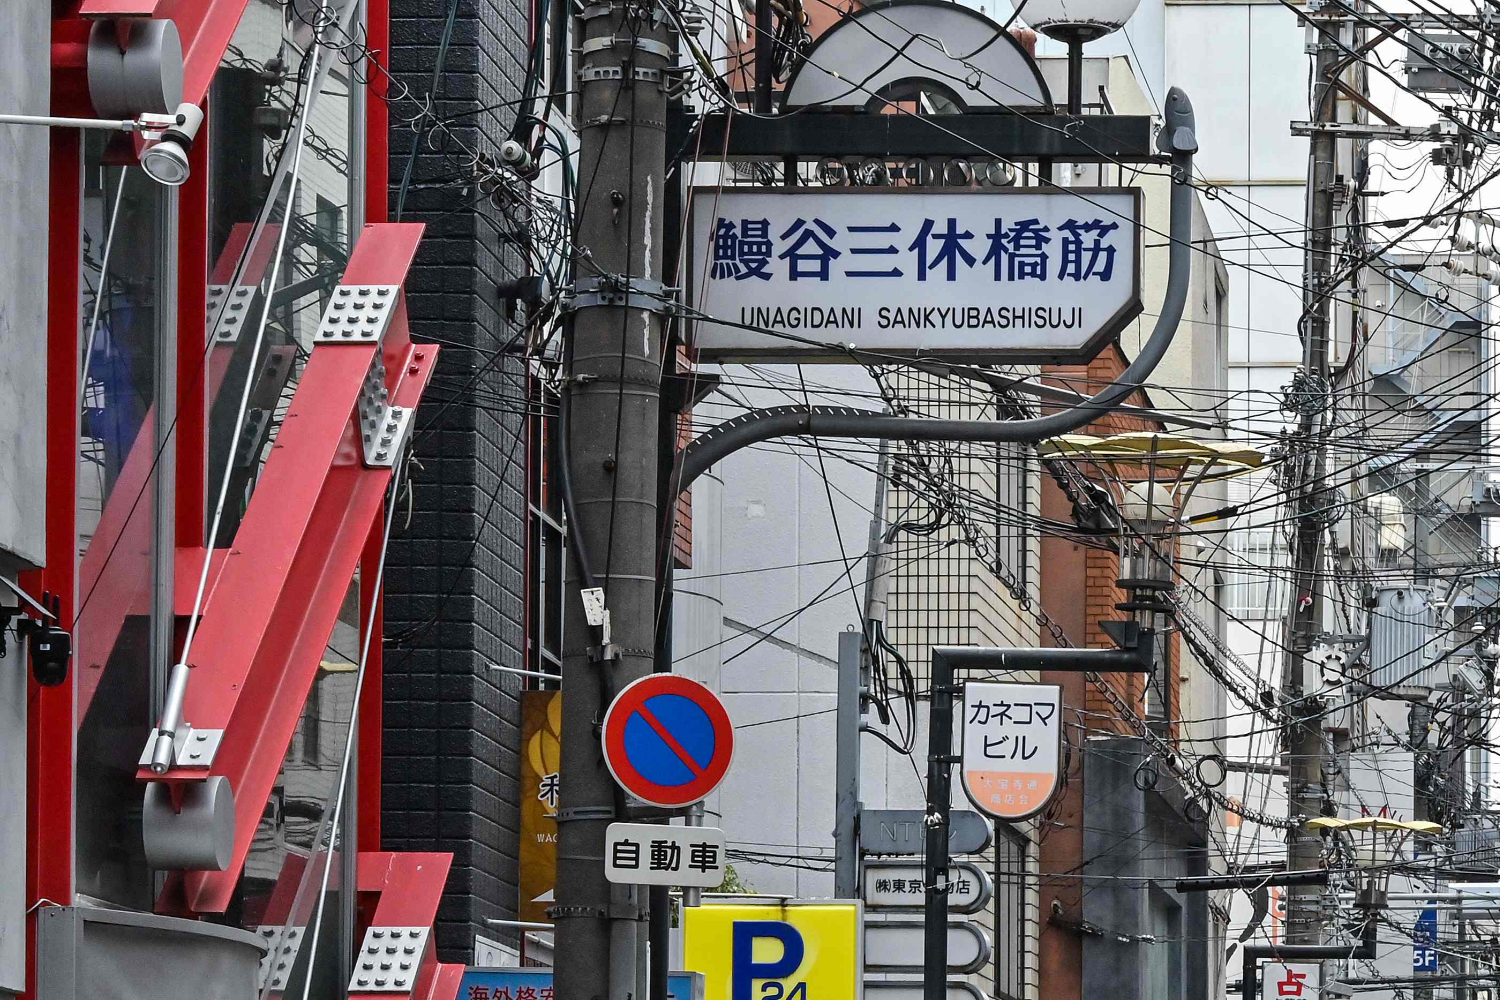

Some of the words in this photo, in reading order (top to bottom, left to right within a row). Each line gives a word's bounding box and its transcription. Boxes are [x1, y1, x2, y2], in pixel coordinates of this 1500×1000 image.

[710, 217, 1119, 283] 鰻谷三休橋筋
[740, 306, 863, 330] UNAGIDANI
[877, 306, 1084, 330] SANKYUBASHISUJI
[968, 700, 1055, 727] カネコマ
[983, 734, 1038, 761] ビル
[612, 838, 720, 873] 自動車
[1277, 969, 1306, 996] 占
